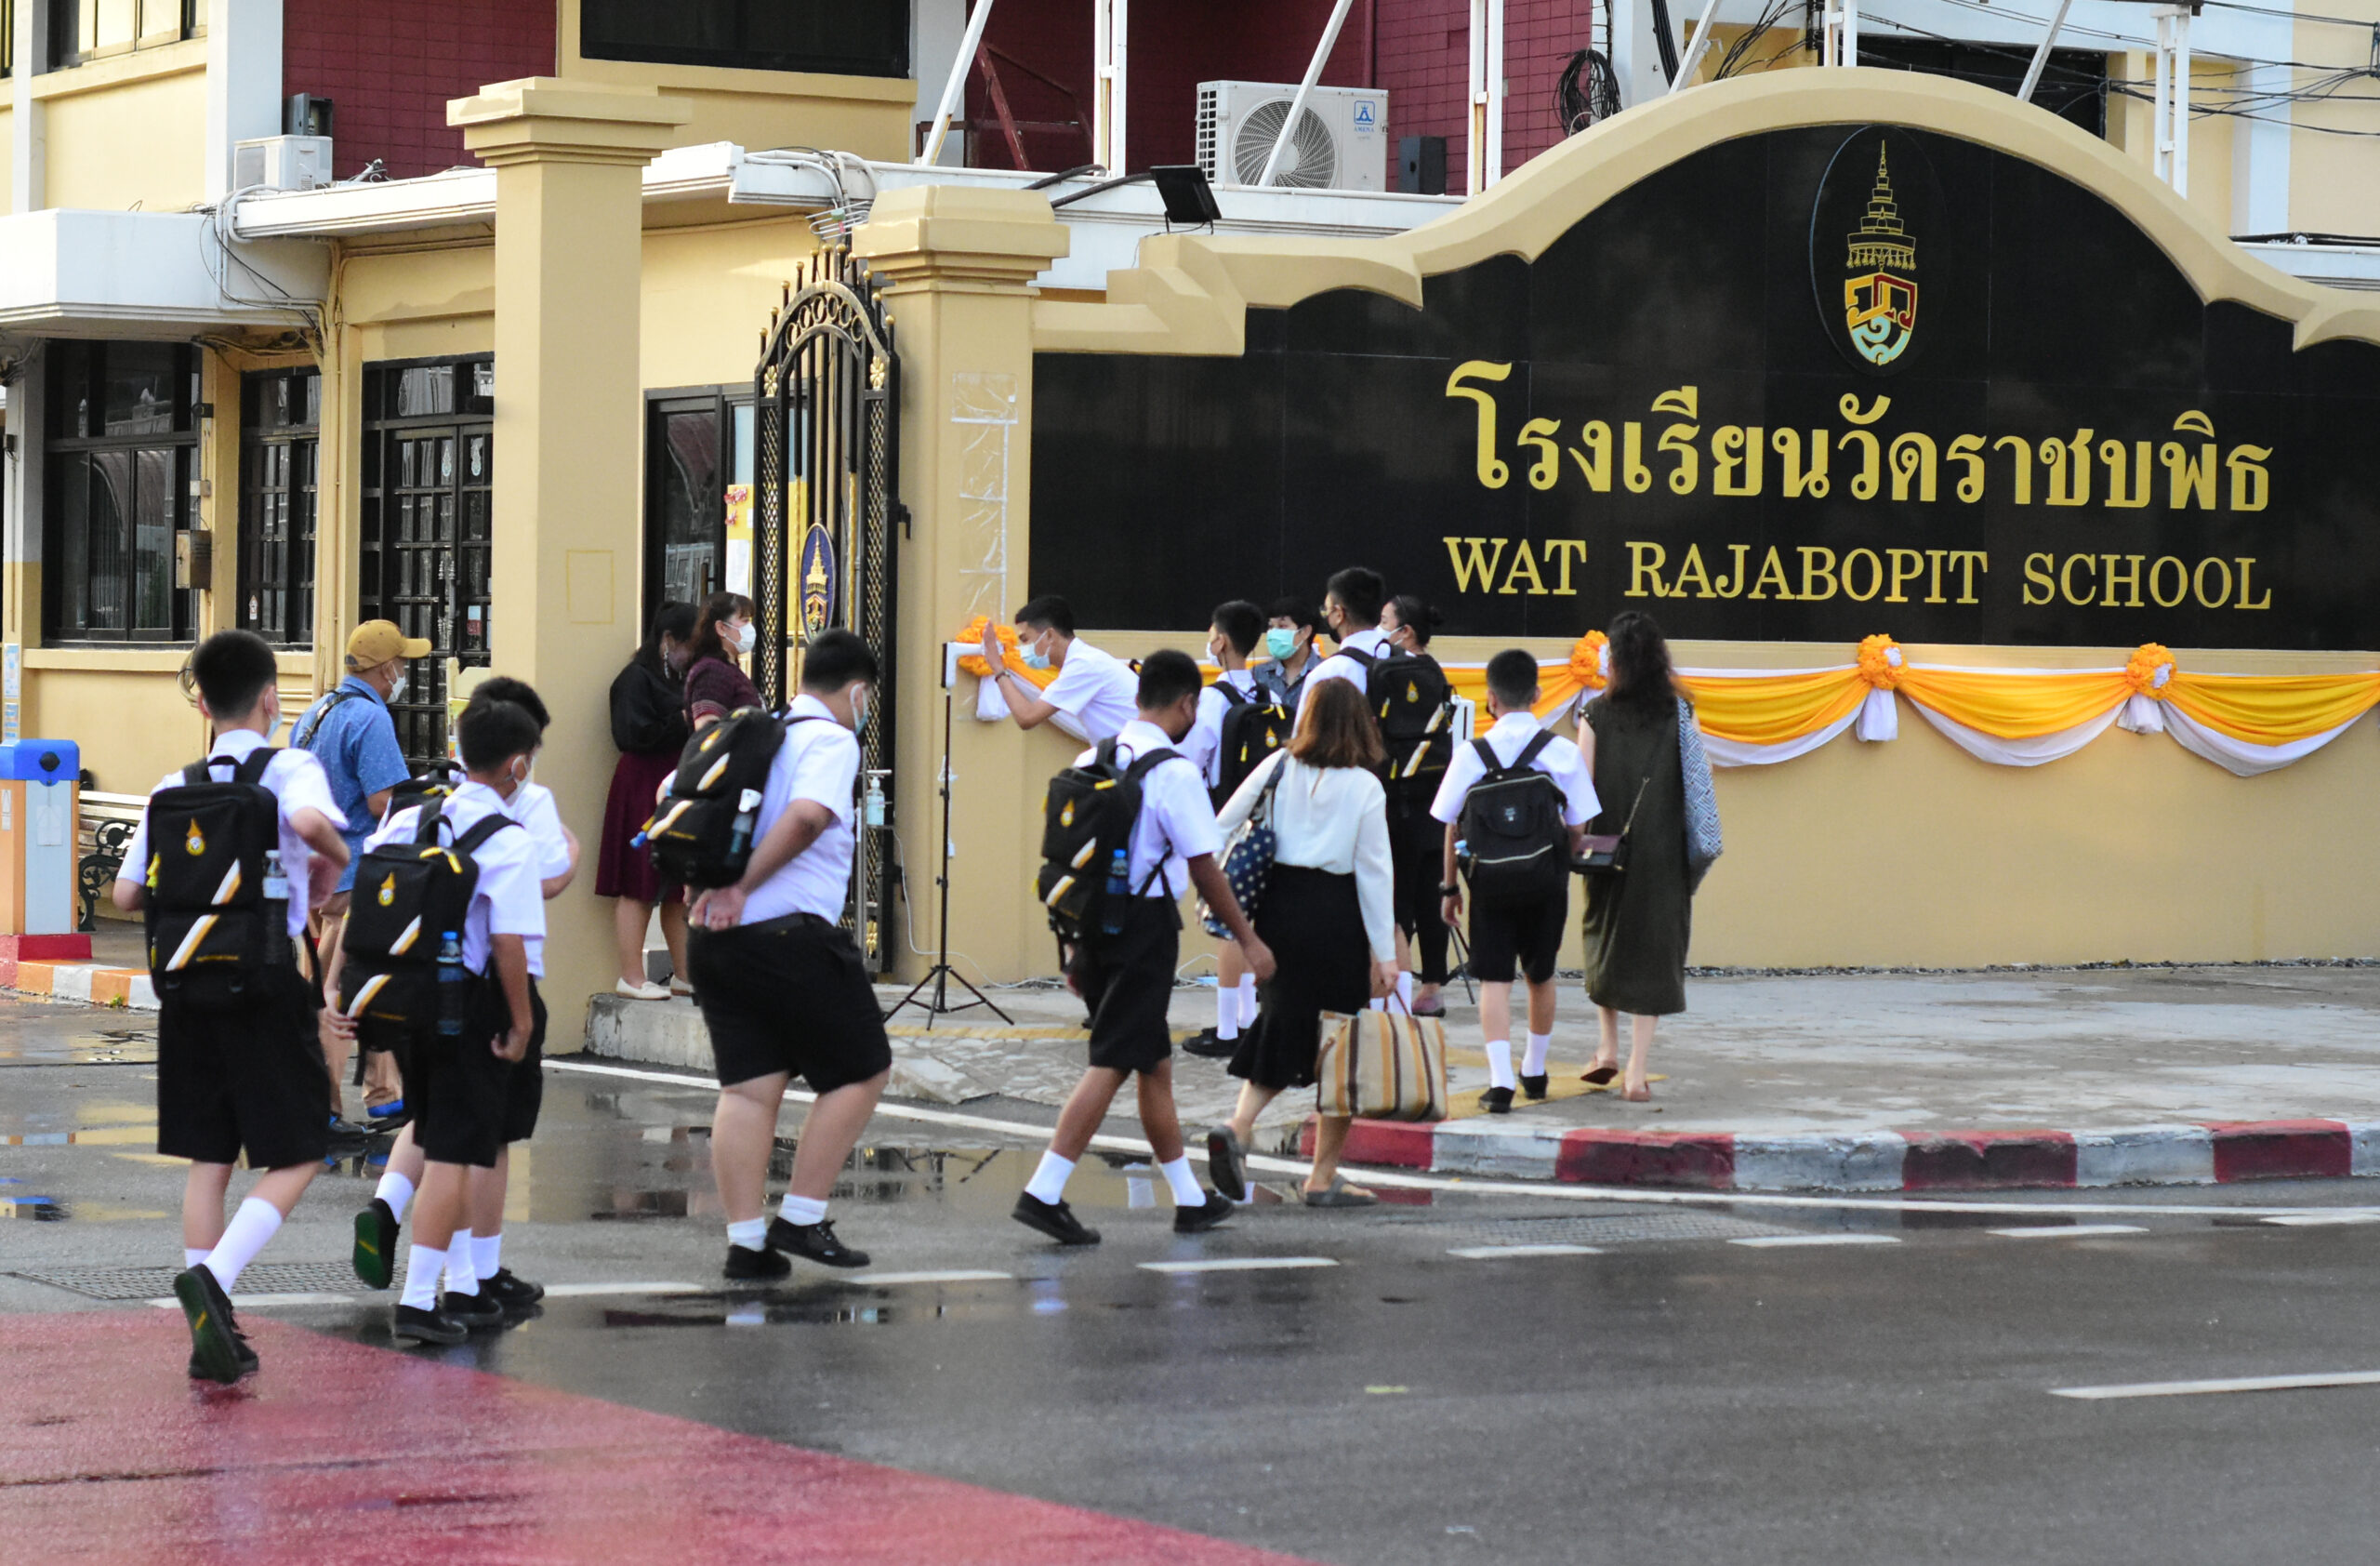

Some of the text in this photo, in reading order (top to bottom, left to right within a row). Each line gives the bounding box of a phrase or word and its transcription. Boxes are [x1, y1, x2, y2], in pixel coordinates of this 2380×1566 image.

[1446, 360, 2273, 511] โรงเรียนวัดราชบพิธ
[1444, 537, 2271, 610] WAT RAJABOPIT SCHOOL
